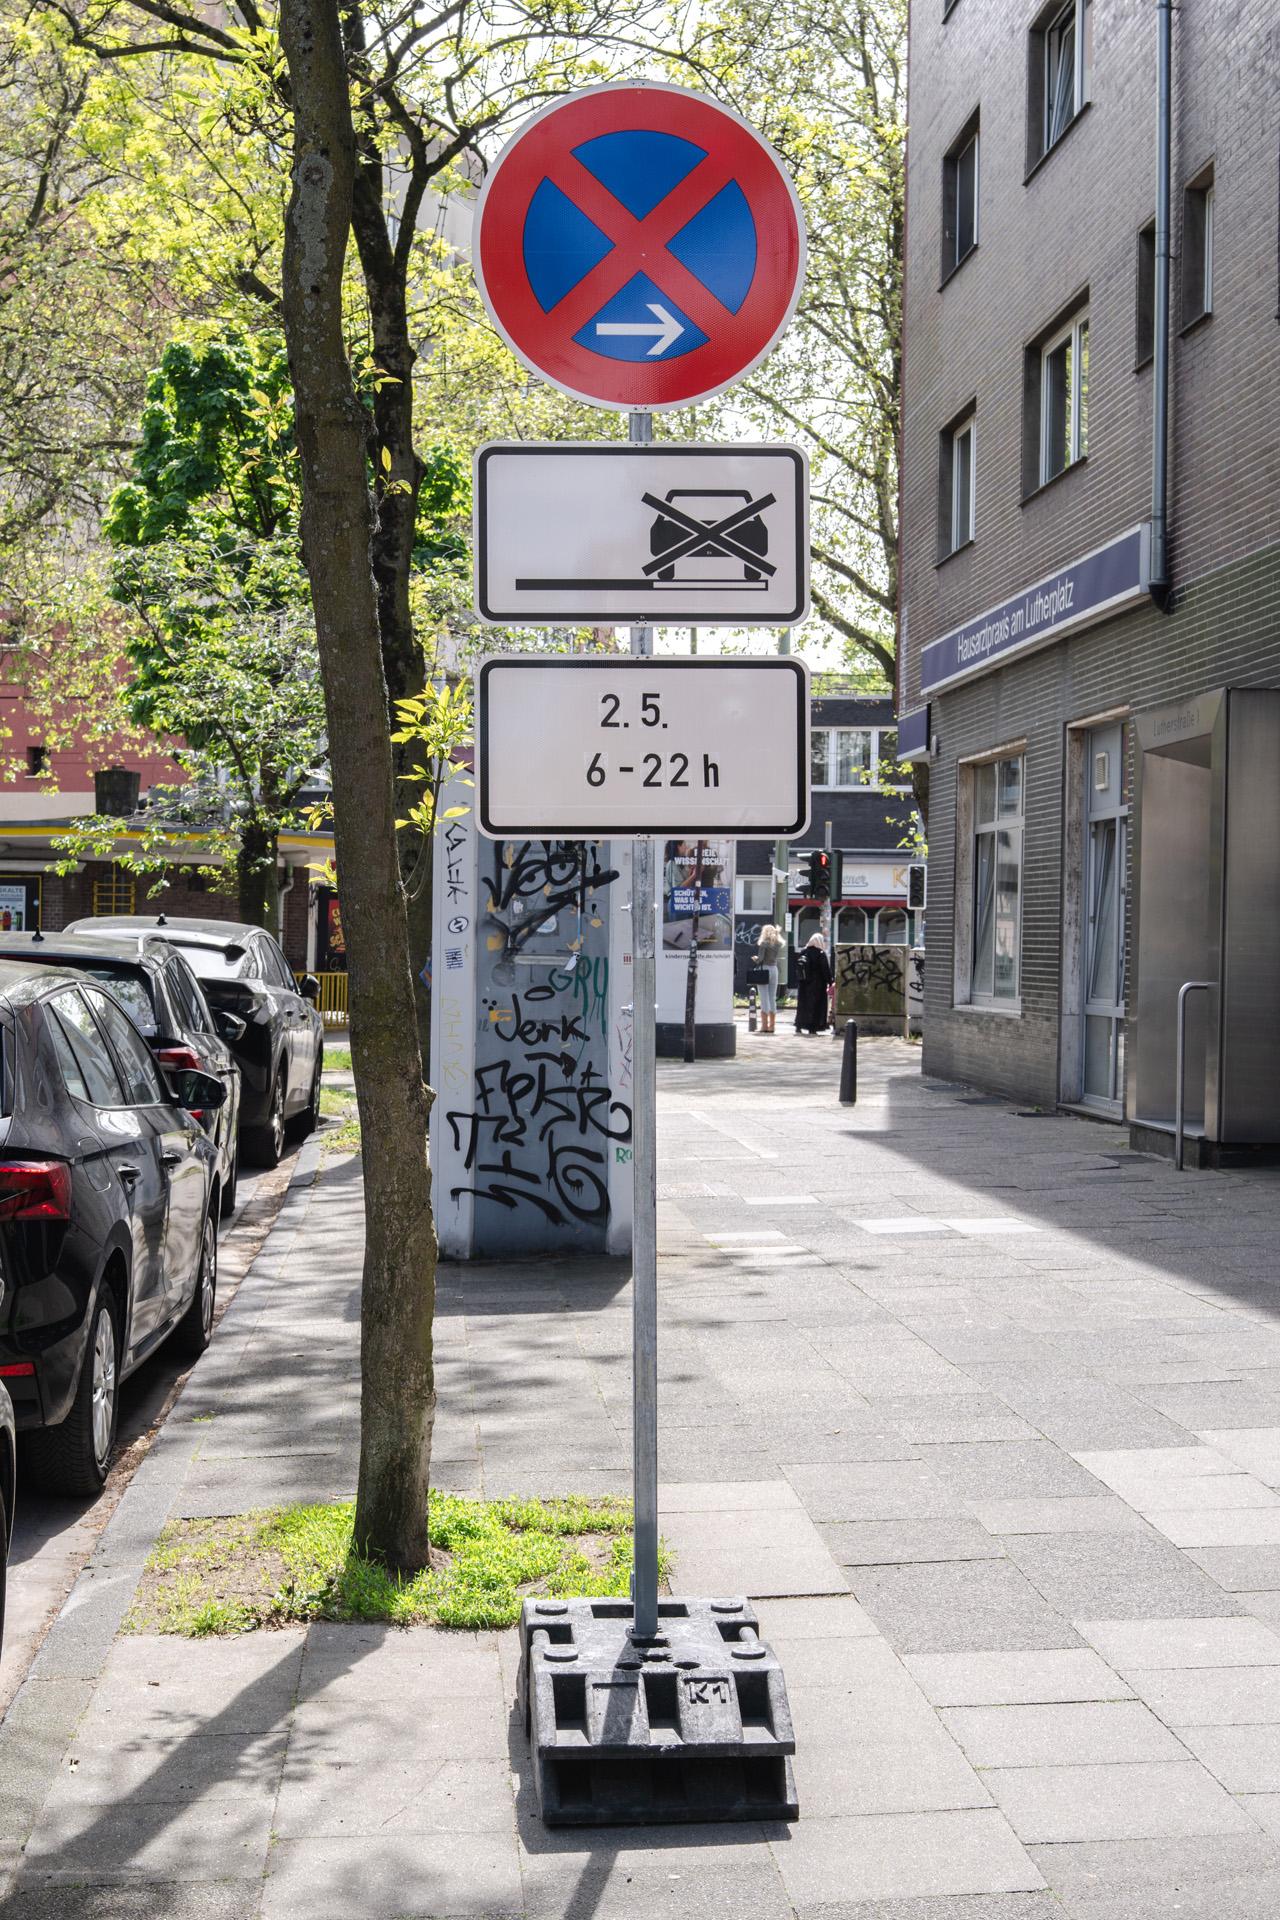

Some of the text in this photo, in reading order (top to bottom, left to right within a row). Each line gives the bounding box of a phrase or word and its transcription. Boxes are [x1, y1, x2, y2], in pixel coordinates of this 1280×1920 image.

[957, 577, 1074, 663] Hausarztpraxis am Lutherplatz
[688, 1682, 727, 1704] K1
